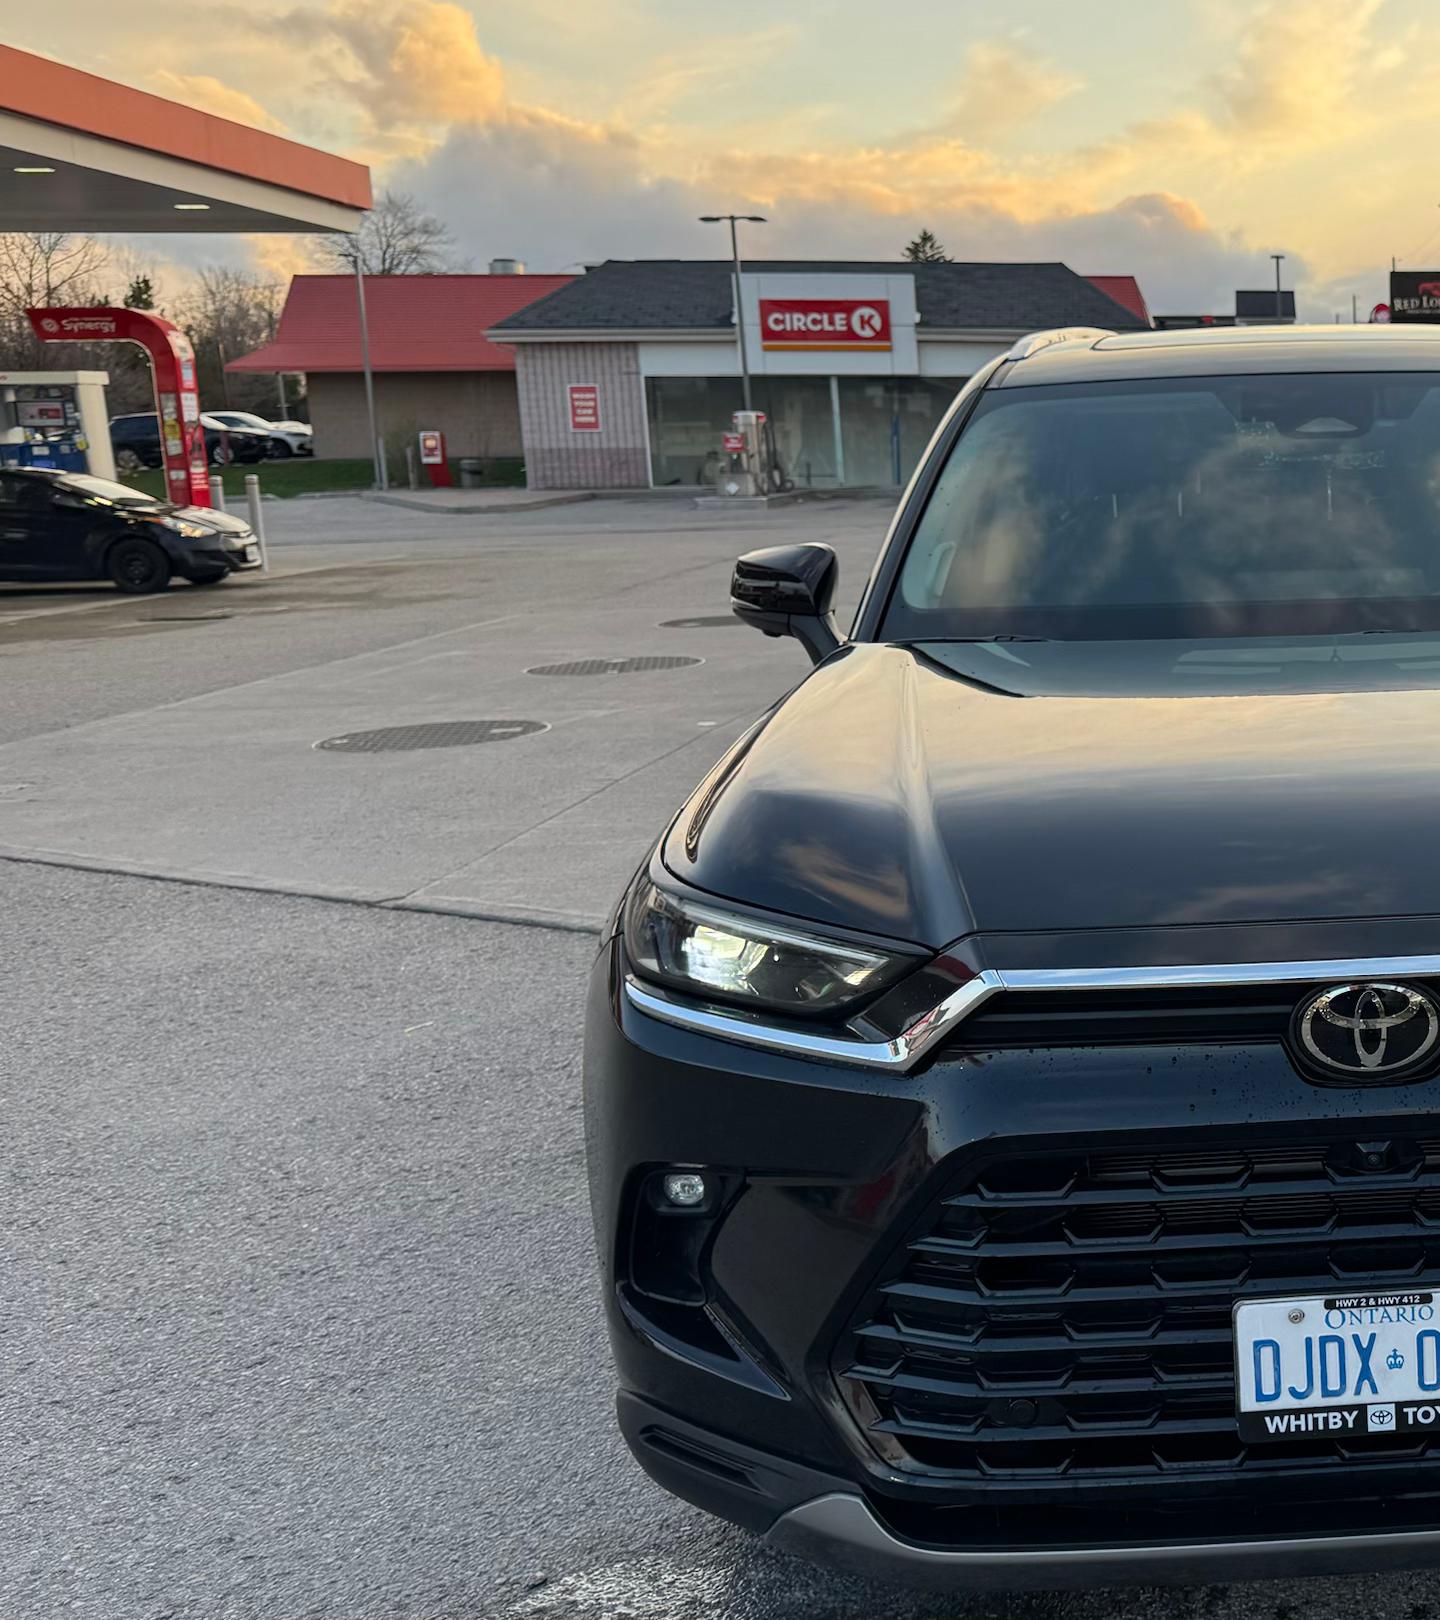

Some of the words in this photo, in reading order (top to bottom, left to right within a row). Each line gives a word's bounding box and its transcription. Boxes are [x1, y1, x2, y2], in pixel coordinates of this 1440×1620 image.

[1393, 297, 1420, 311] RED
[767, 312, 848, 331] CIRCLE
[1336, 1298, 1359, 1308] HWY
[1360, 1298, 1367, 1306] 2
[1369, 1298, 1376, 1306] &
[1378, 1296, 1402, 1306] HWY
[1402, 1295, 1420, 1304] 412
[1324, 1305, 1434, 1329] ONTARIO
[1252, 1332, 1379, 1403] DJDX
[1265, 1410, 1359, 1434] WHITBY
